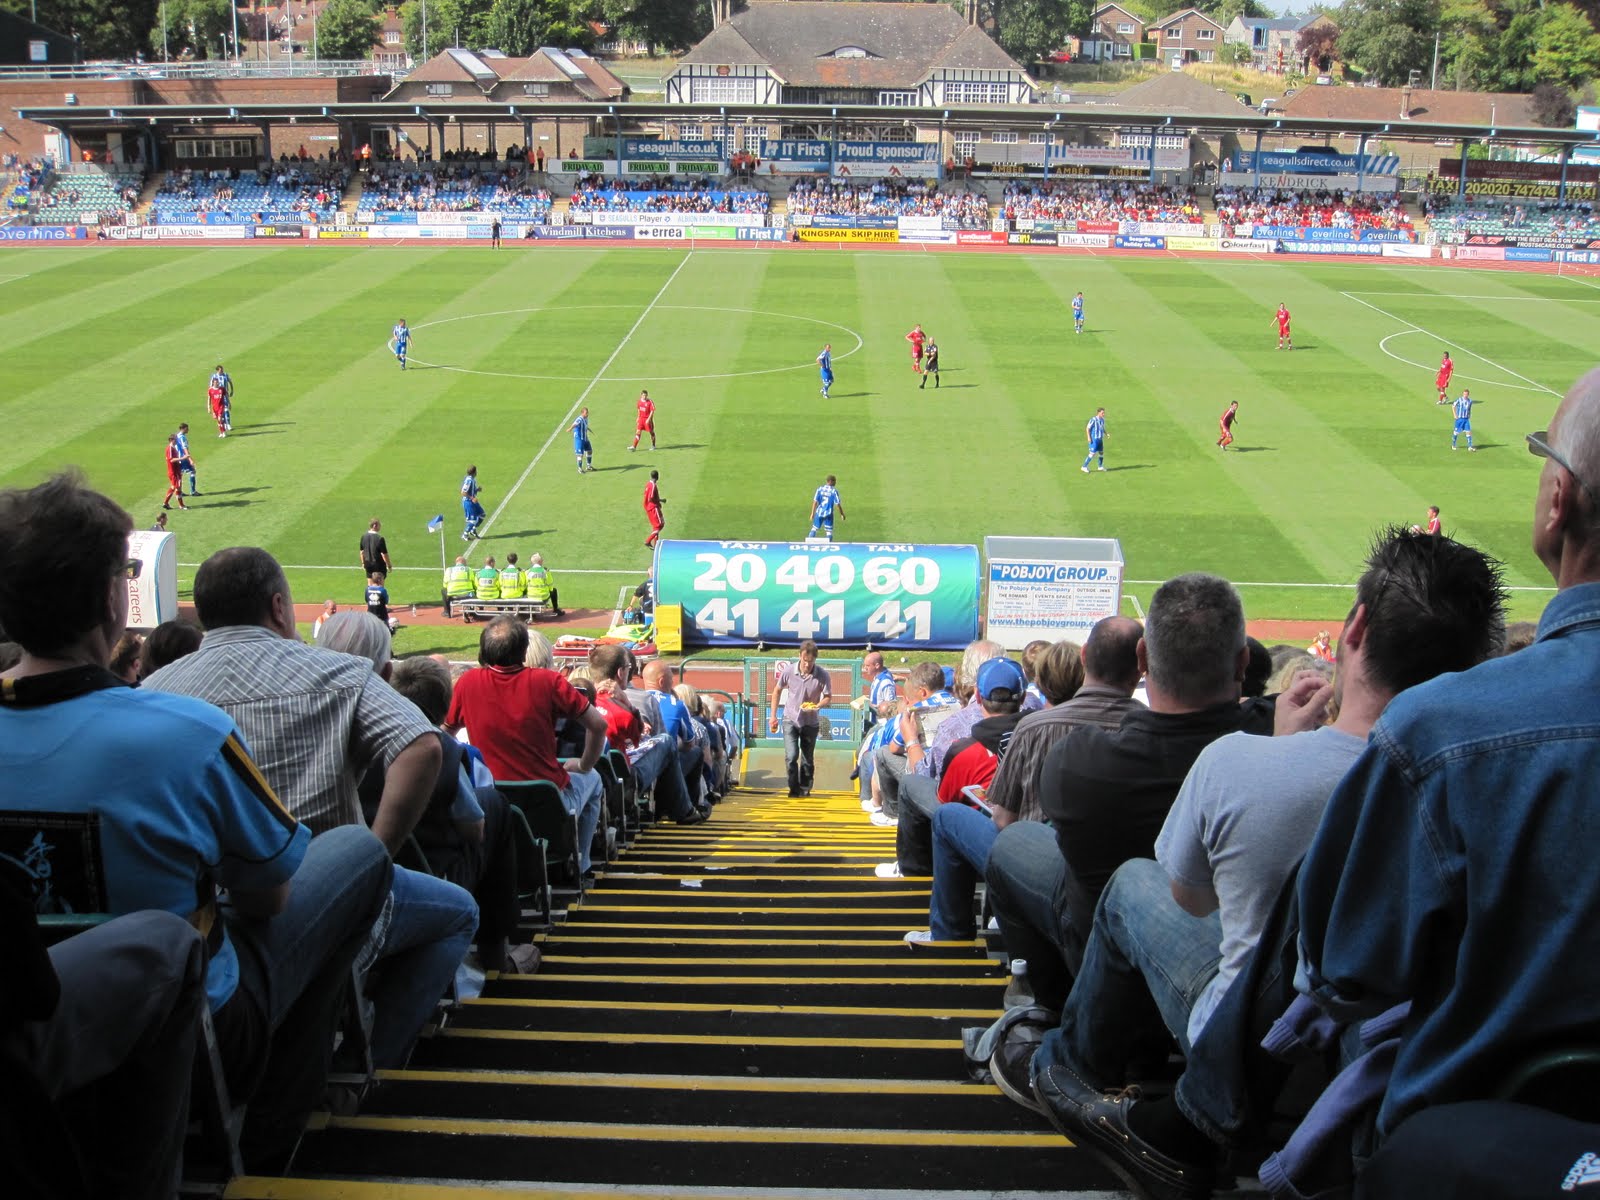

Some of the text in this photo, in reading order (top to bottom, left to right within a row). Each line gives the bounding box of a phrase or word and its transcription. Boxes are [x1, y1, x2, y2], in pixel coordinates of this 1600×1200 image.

[638, 142, 718, 156] seagulls.co.uk
[782, 143, 825, 156] IT First
[838, 143, 923, 159] Proud sponsor
[1263, 156, 1356, 168] seagullsdirect.co.uk
[1108, 169, 1143, 177] AMBER
[1259, 176, 1328, 188] KENDRICK
[1428, 180, 1459, 190] TAXI
[1464, 182, 1557, 197] 202020-747474
[1566, 186, 1596, 196] TAXI
[161, 215, 196, 223] overline
[640, 215, 662, 224] Player
[0, 228, 65, 239] overline
[112, 227, 126, 236] rdf
[143, 227, 157, 236] rdf
[160, 227, 179, 236] The
[181, 227, 204, 238] Argus
[540, 227, 627, 236] Windmill Kitchens
[652, 228, 682, 238] errea
[738, 228, 747, 239] IT
[749, 228, 772, 240] First
[801, 230, 848, 238] KINGSPAN
[1256, 227, 1294, 237] overline
[1312, 228, 1350, 239] overline
[1060, 234, 1078, 244] The
[1080, 235, 1107, 246] Argus
[1123, 241, 1143, 249] Holiday
[1221, 240, 1266, 250] Colourfast
[1298, 243, 1332, 252] 20 20 20
[1345, 243, 1380, 253] 20 40 60
[1555, 251, 1588, 261] IT First
[720, 541, 915, 553] TAXI 01273 TAXI
[693, 553, 940, 595] 20 40 60
[1001, 565, 1055, 579] POBJOY
[1056, 566, 1108, 581] GROUP
[129, 579, 143, 624] careers
[695, 598, 932, 640] 41 41 41
[989, 618, 1096, 627] www.thepobjoygroup.c
